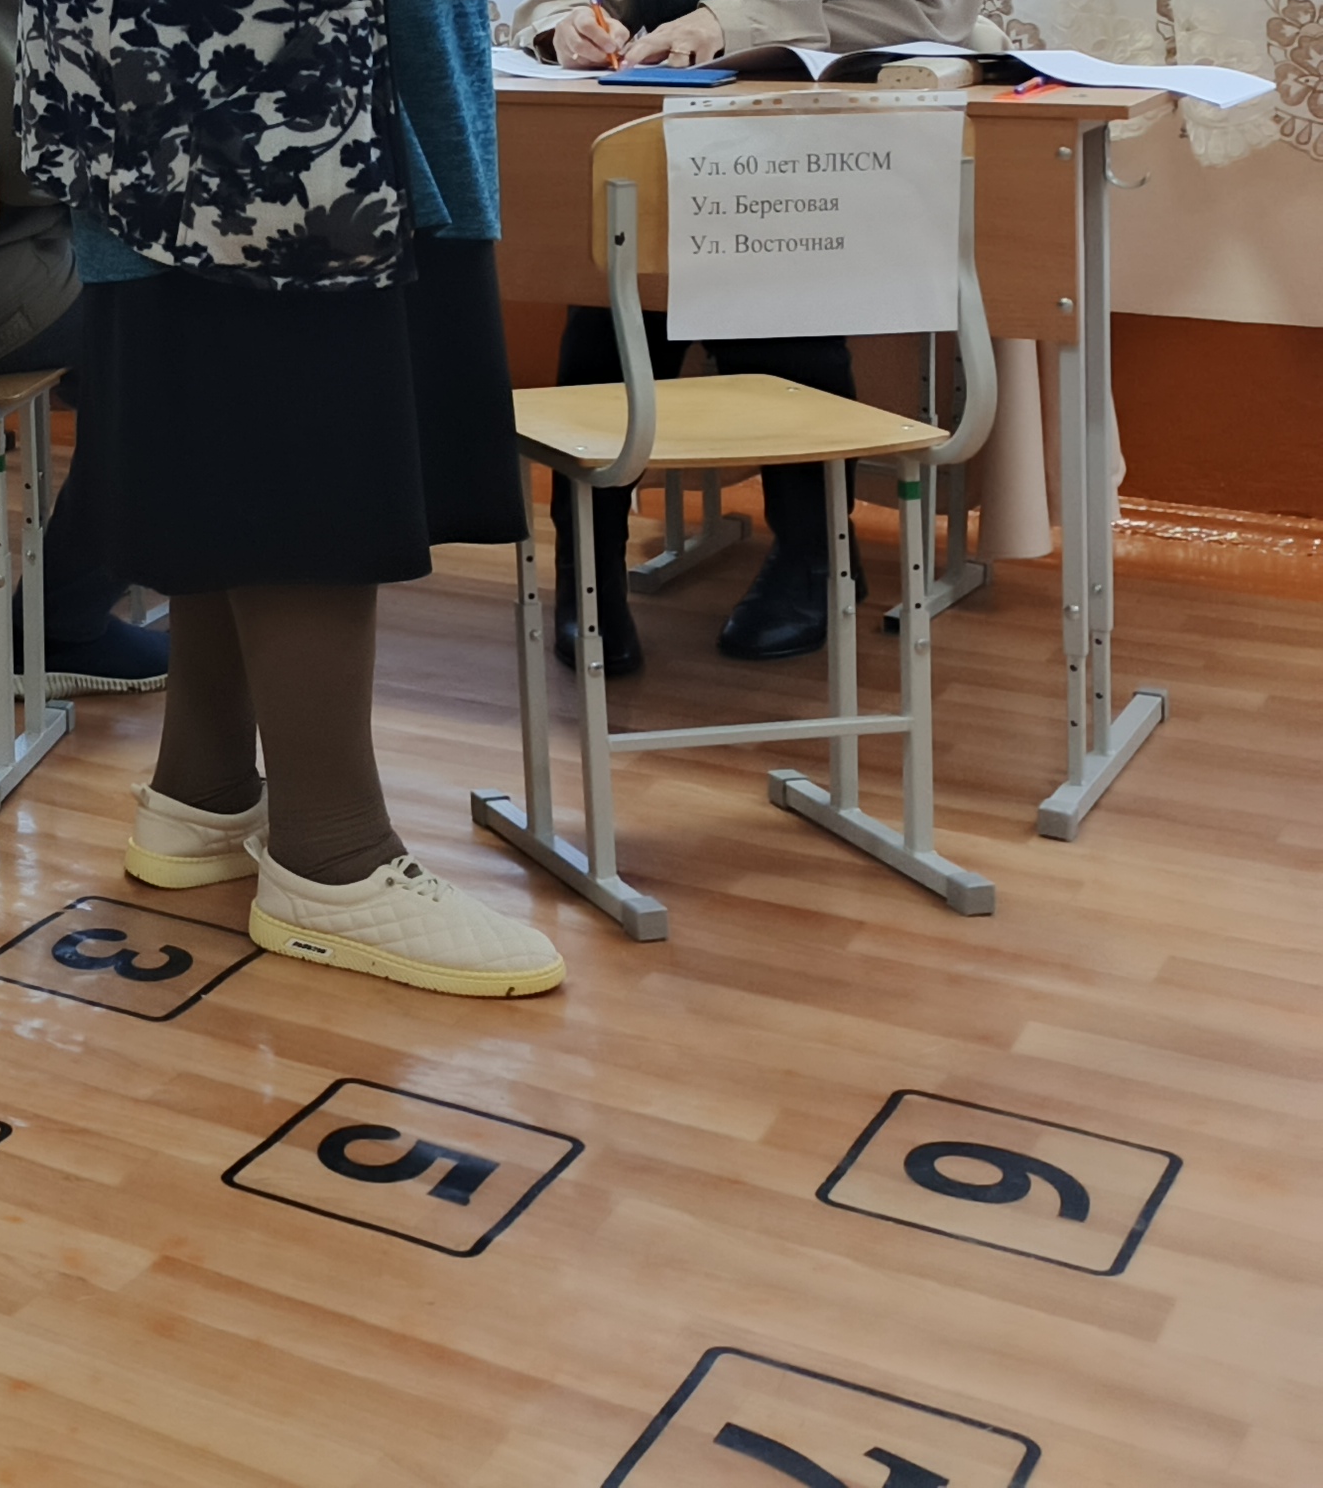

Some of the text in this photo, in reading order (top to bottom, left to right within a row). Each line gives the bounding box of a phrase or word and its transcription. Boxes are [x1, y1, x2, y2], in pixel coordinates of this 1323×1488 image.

[690, 151, 892, 176] Ул. 60 лет ВЛКСМ
[690, 195, 840, 219] Ул. Береговая
[690, 234, 845, 254] Ул. Восточная
[51, 927, 193, 982] 3
[316, 1124, 501, 1206] 5
[902, 1140, 1092, 1223] 6
